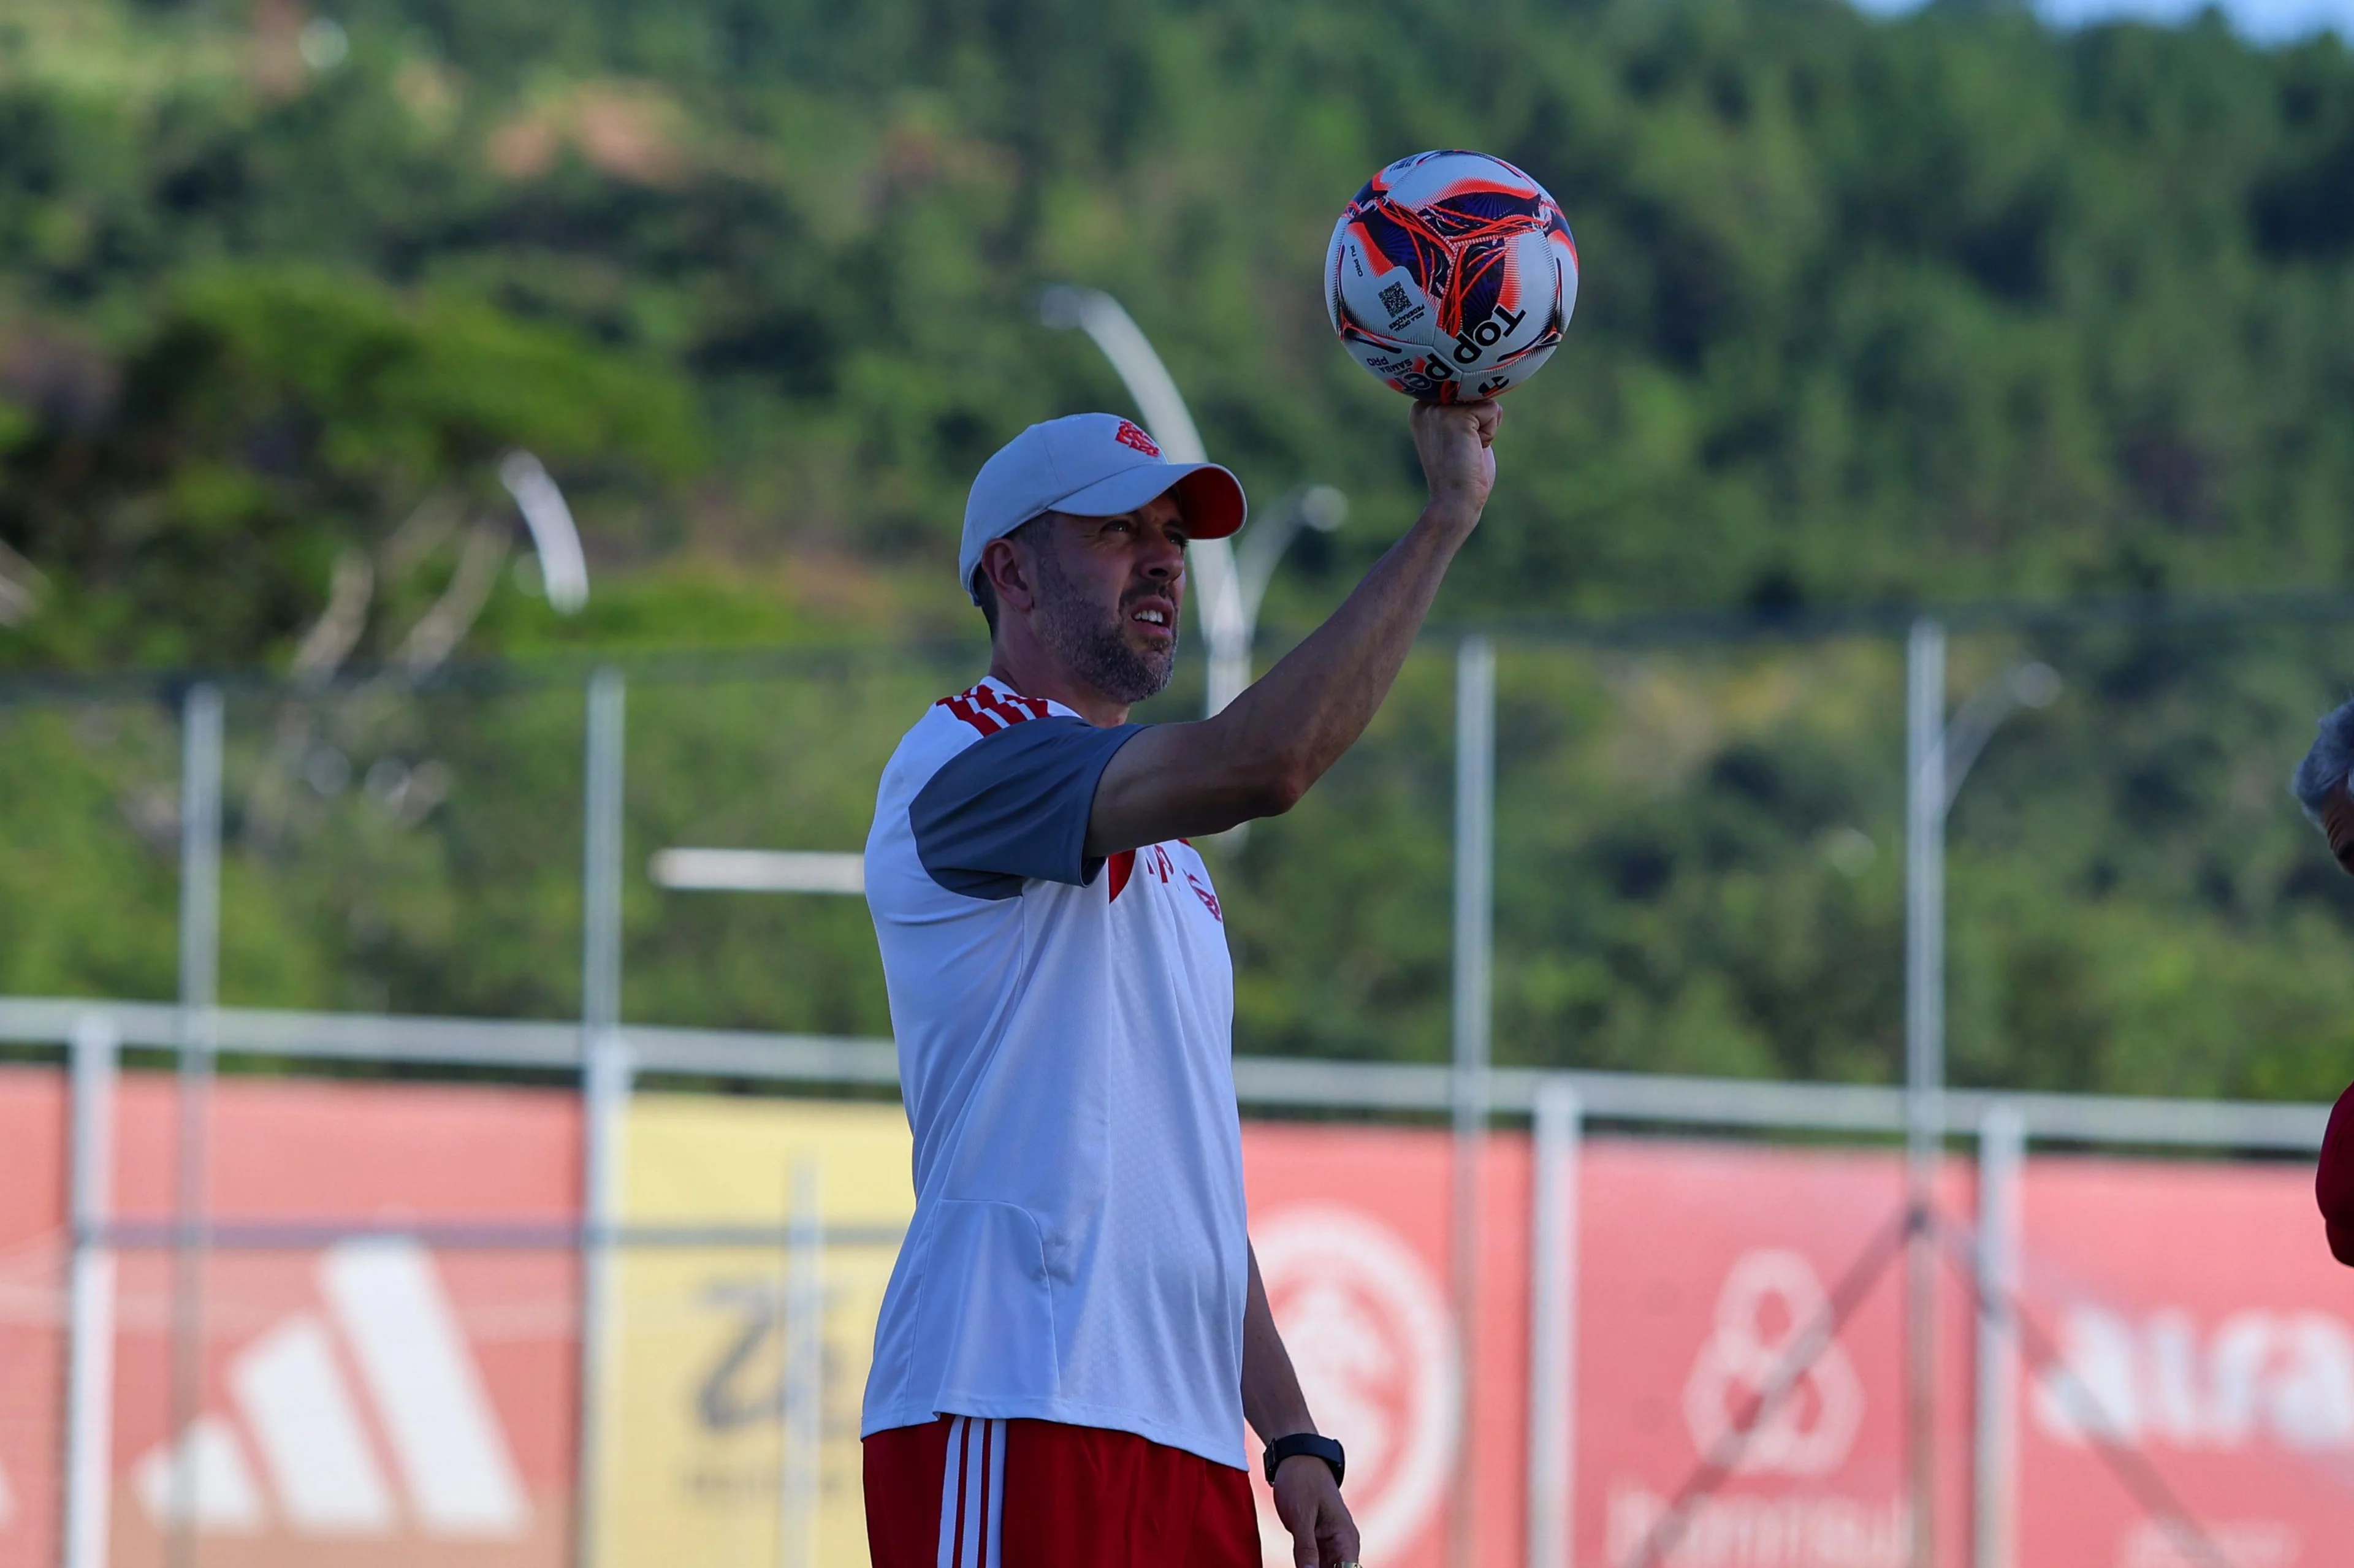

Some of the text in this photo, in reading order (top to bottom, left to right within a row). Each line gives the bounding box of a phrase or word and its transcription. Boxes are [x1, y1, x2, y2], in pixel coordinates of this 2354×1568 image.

[1350, 245, 1363, 277] PU PRO
[1366, 356, 1390, 367] PRO
[1378, 358, 1414, 373] SAMBA
